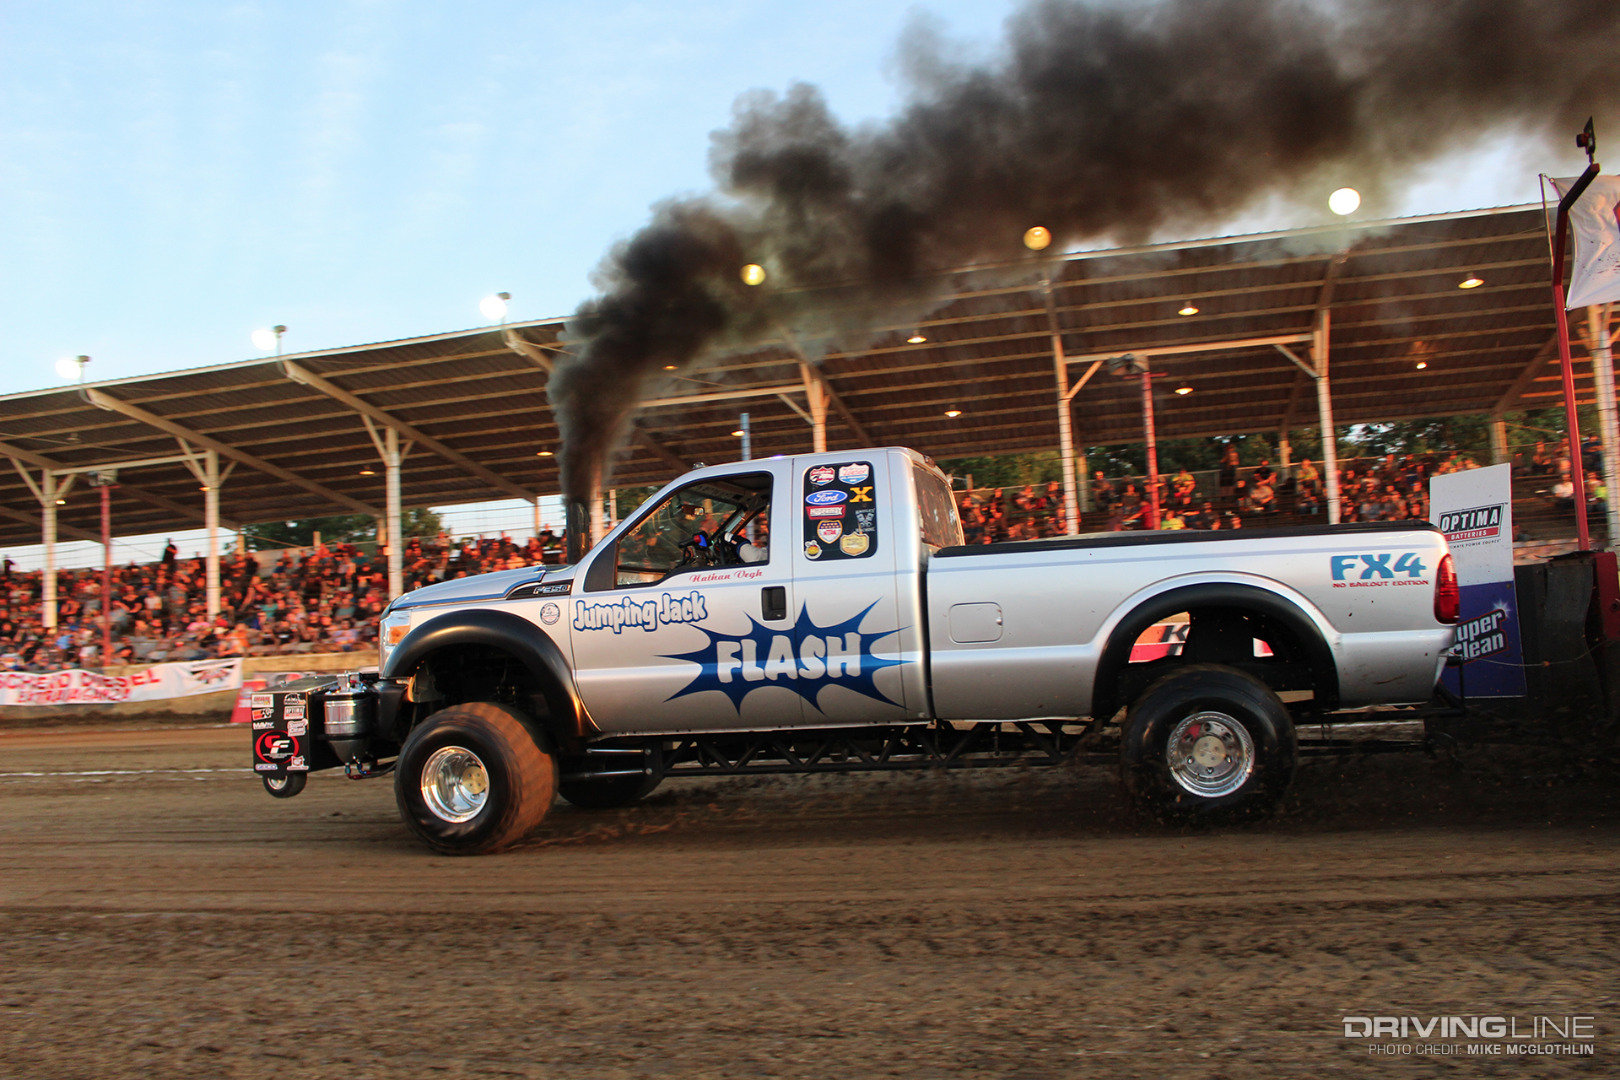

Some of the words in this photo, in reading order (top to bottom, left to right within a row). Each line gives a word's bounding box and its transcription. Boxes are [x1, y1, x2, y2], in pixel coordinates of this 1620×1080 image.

[813, 492, 840, 503] Ford
[1441, 508, 1500, 532] OPTIMA
[1450, 530, 1487, 540] BATTERIES
[689, 572, 731, 583] Nathan
[733, 569, 763, 580] Vegh
[1330, 552, 1427, 581] FX4
[1349, 580, 1389, 588] BAILOUT
[573, 596, 657, 634] Jumping
[659, 590, 708, 625] Jack
[1454, 612, 1503, 642] uper
[716, 632, 862, 684] FLASH
[80, 668, 160, 690] DIESEL
